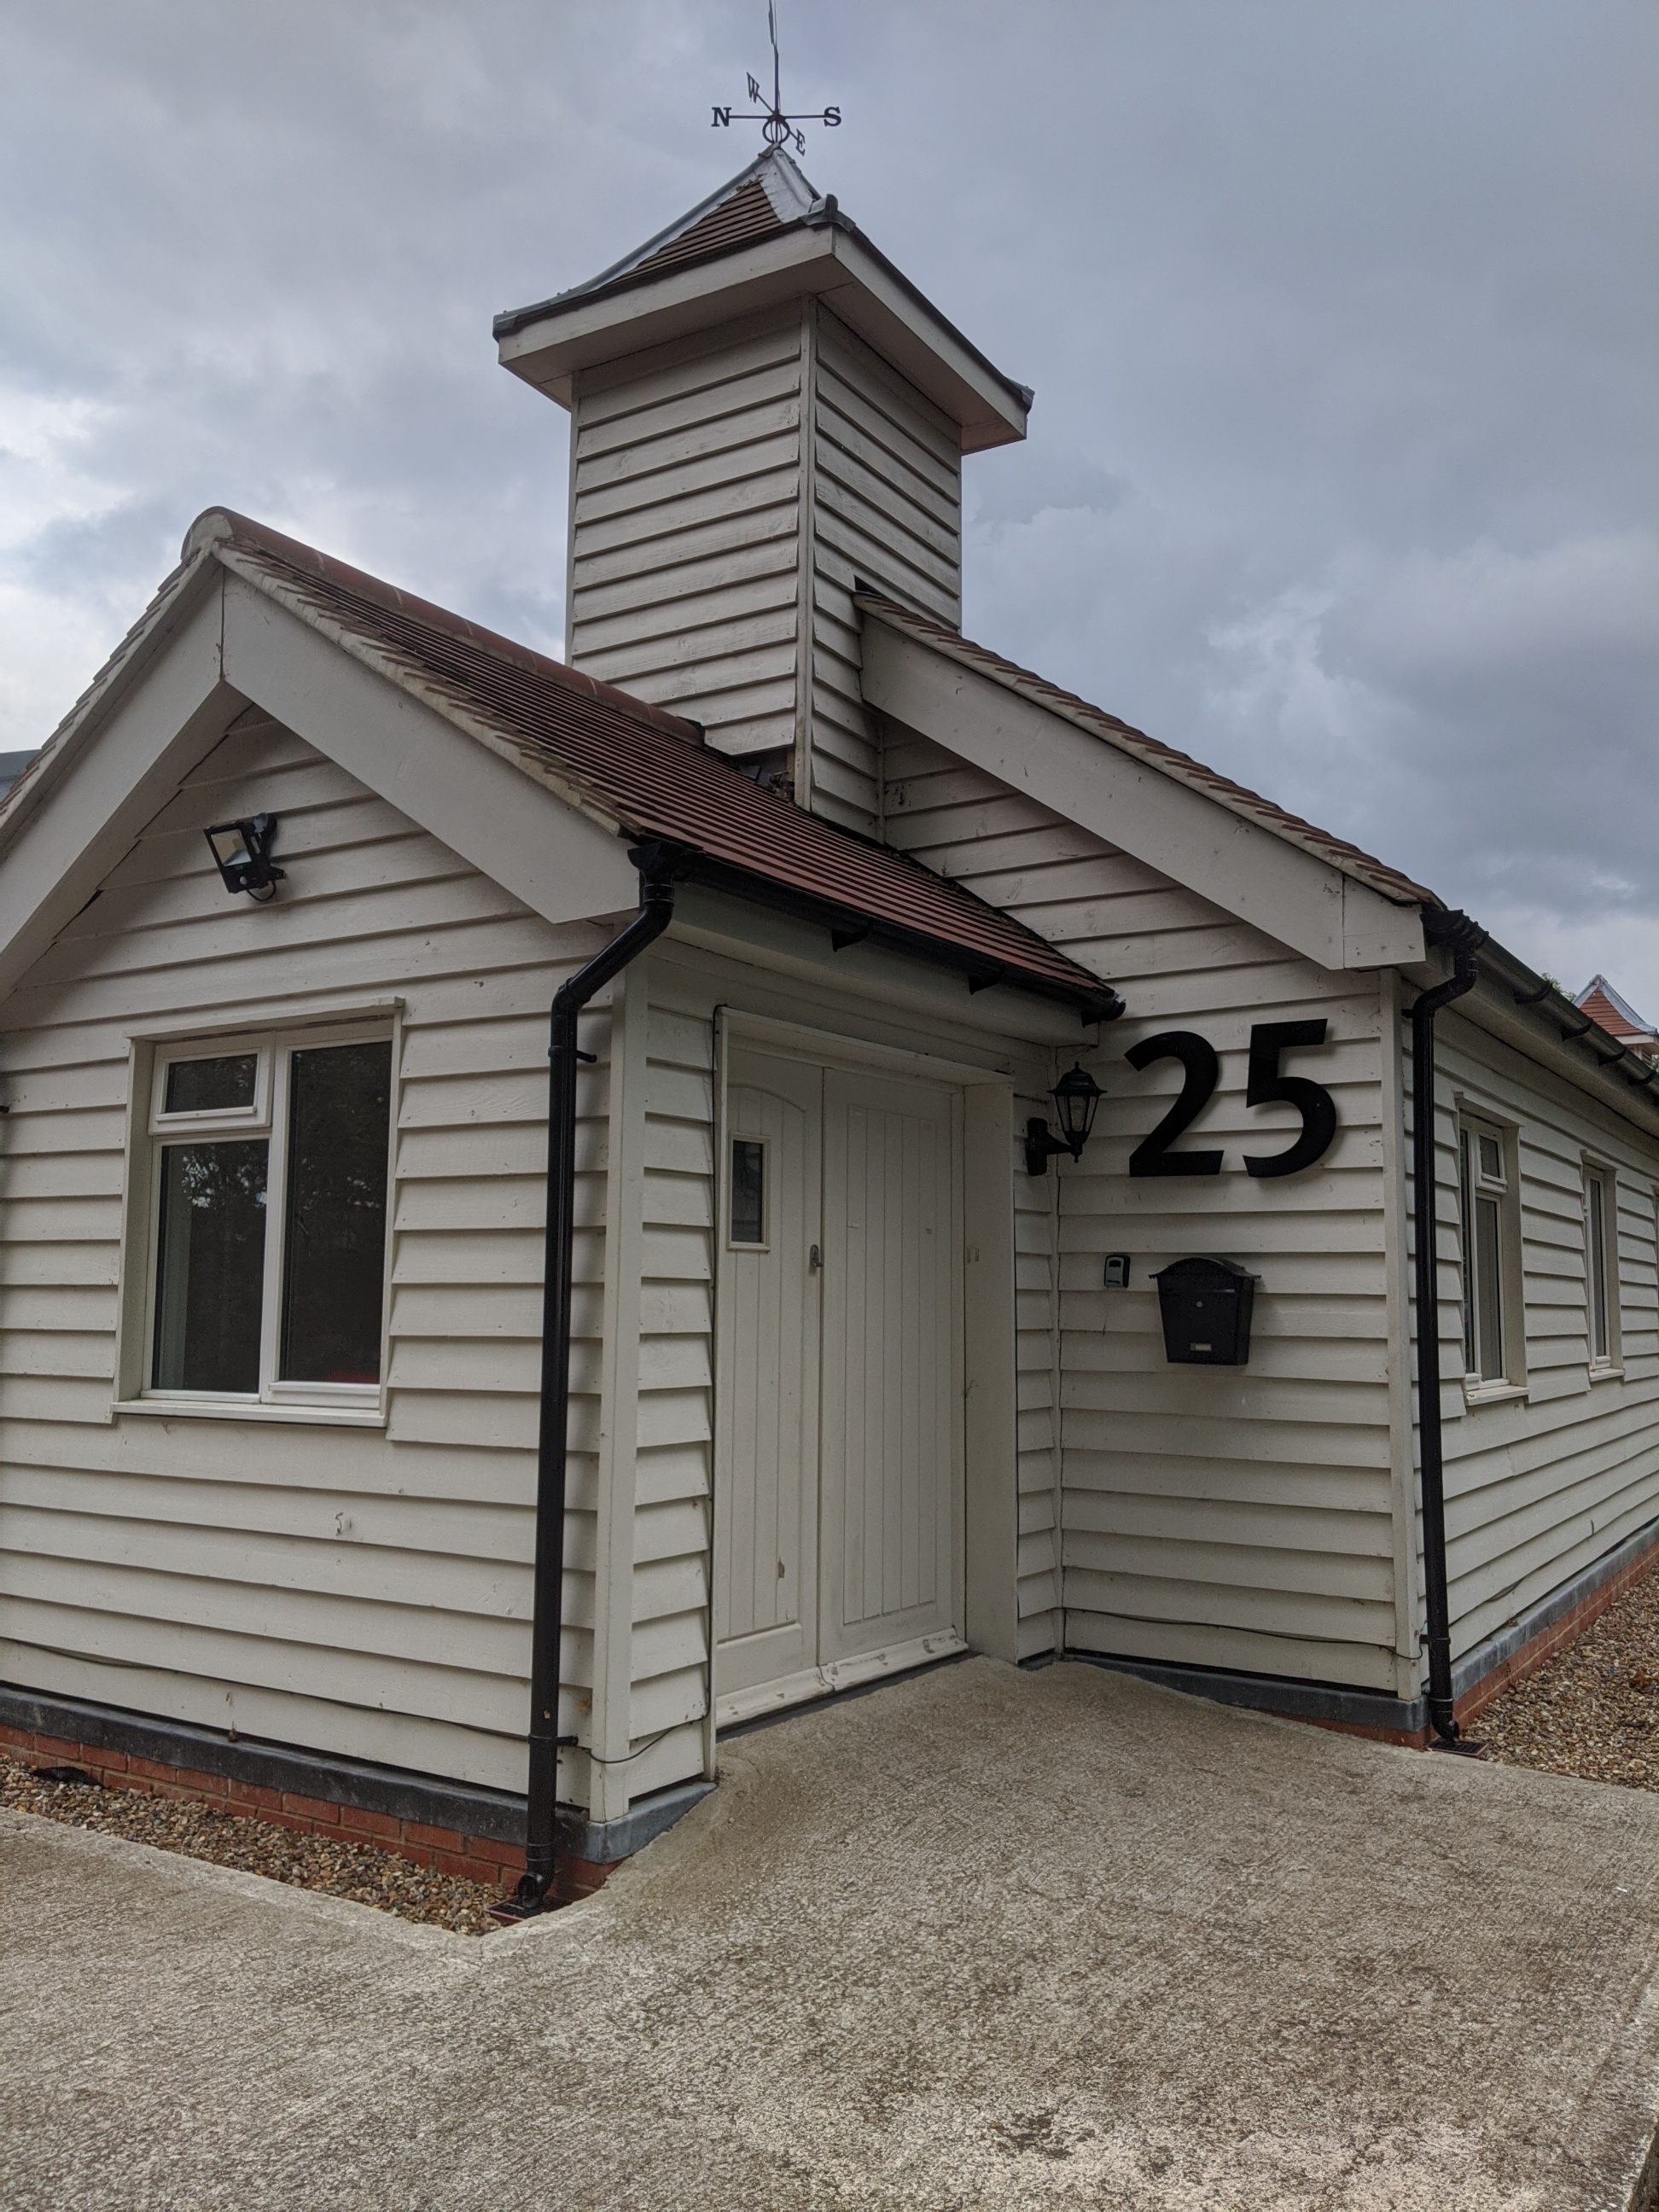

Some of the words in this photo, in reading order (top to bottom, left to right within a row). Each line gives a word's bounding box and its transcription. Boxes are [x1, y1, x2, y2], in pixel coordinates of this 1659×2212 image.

[746, 72, 760, 103] W
[711, 107, 731, 127] N
[824, 107, 841, 126] S
[795, 128, 806, 156] E
[1124, 1018, 1336, 1178] 25
